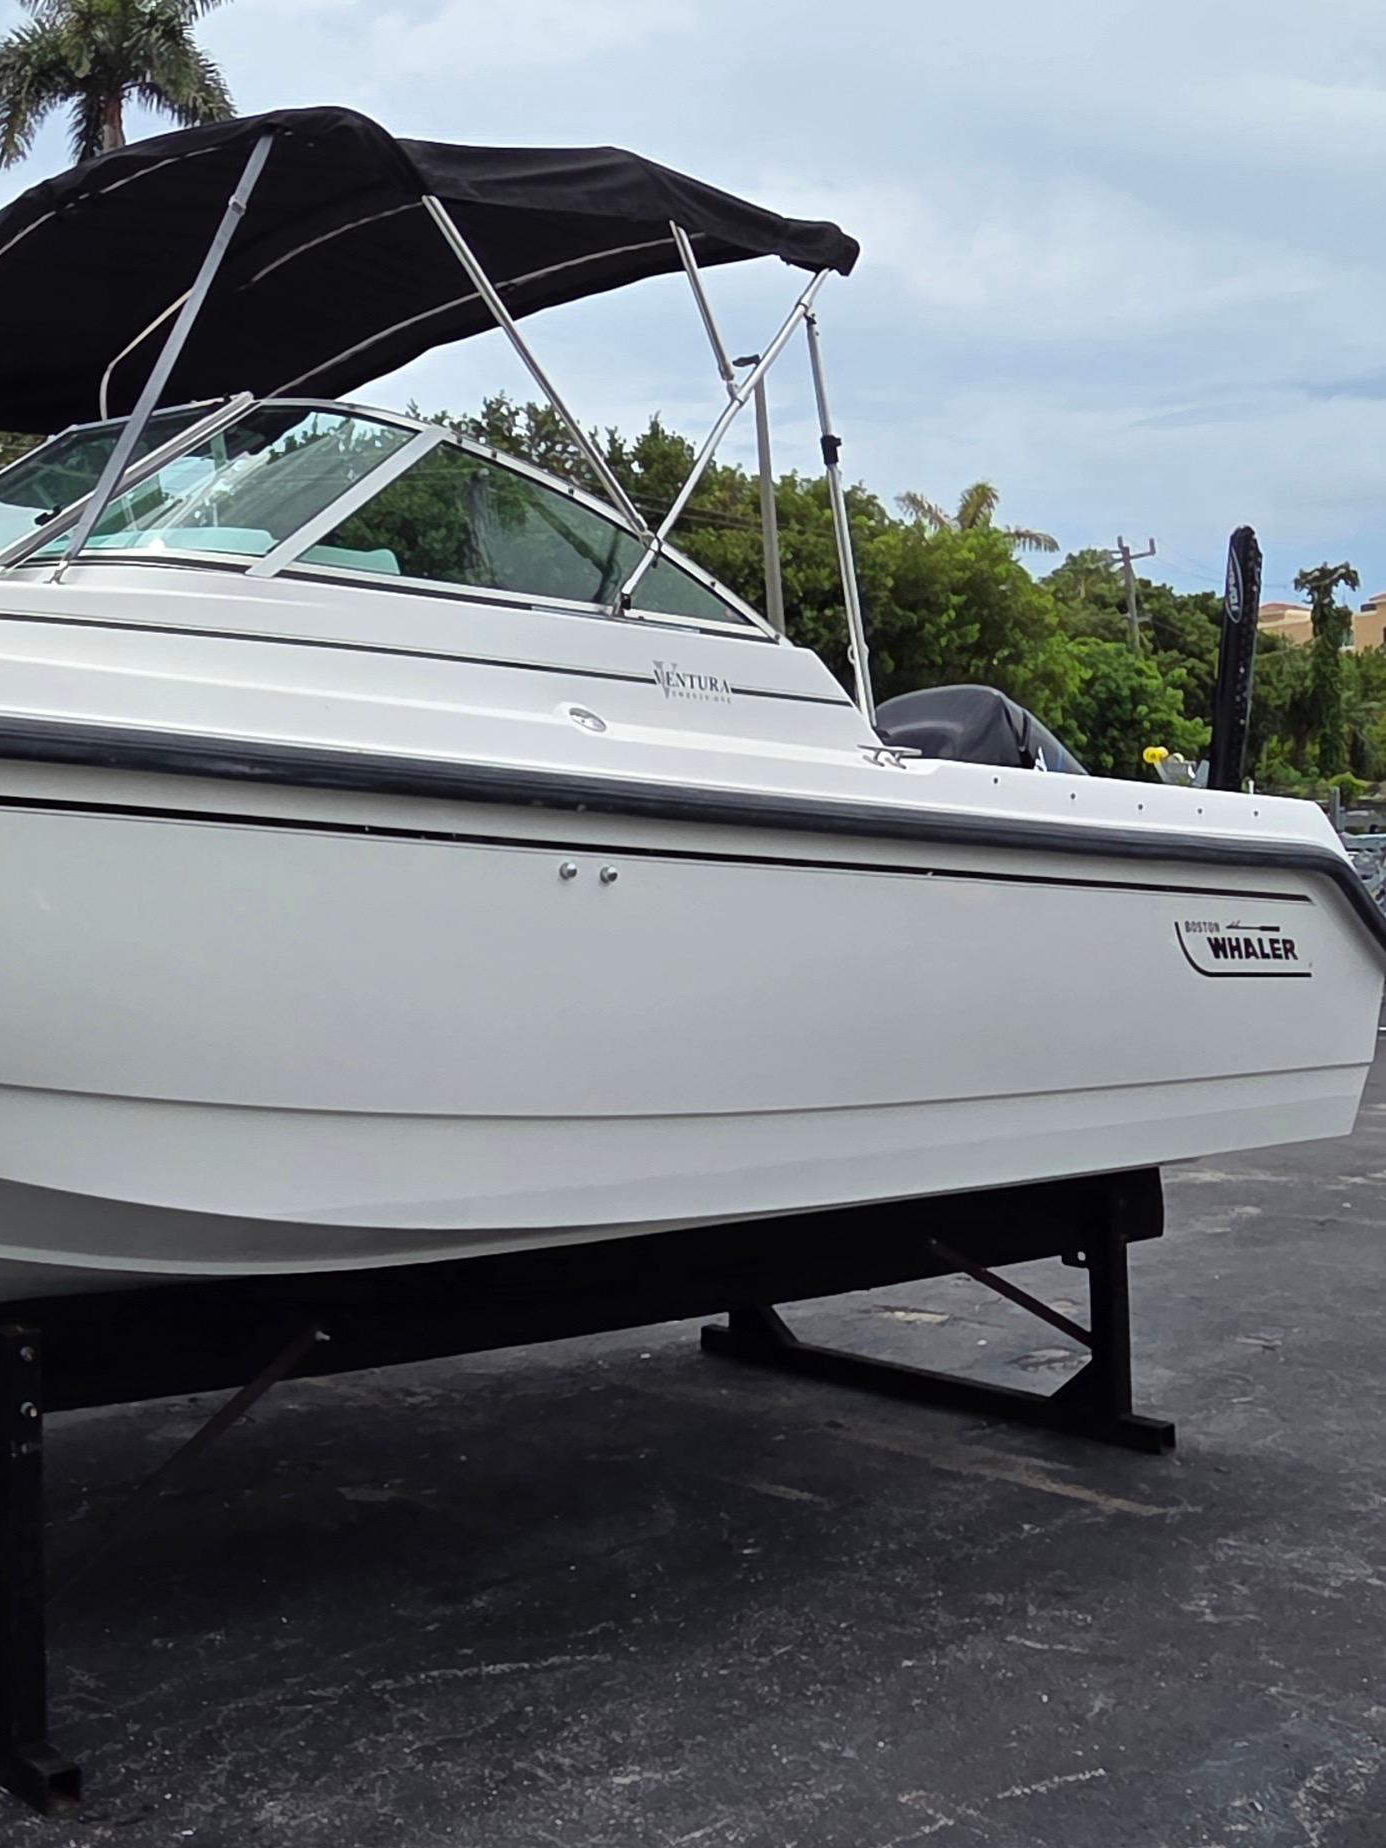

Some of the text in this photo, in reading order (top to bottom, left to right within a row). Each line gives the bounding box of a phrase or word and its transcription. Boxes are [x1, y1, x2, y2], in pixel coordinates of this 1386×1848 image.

[653, 664, 731, 696] VENTURA
[1184, 920, 1220, 933] BOSTON
[1206, 936, 1299, 960] WHALER
